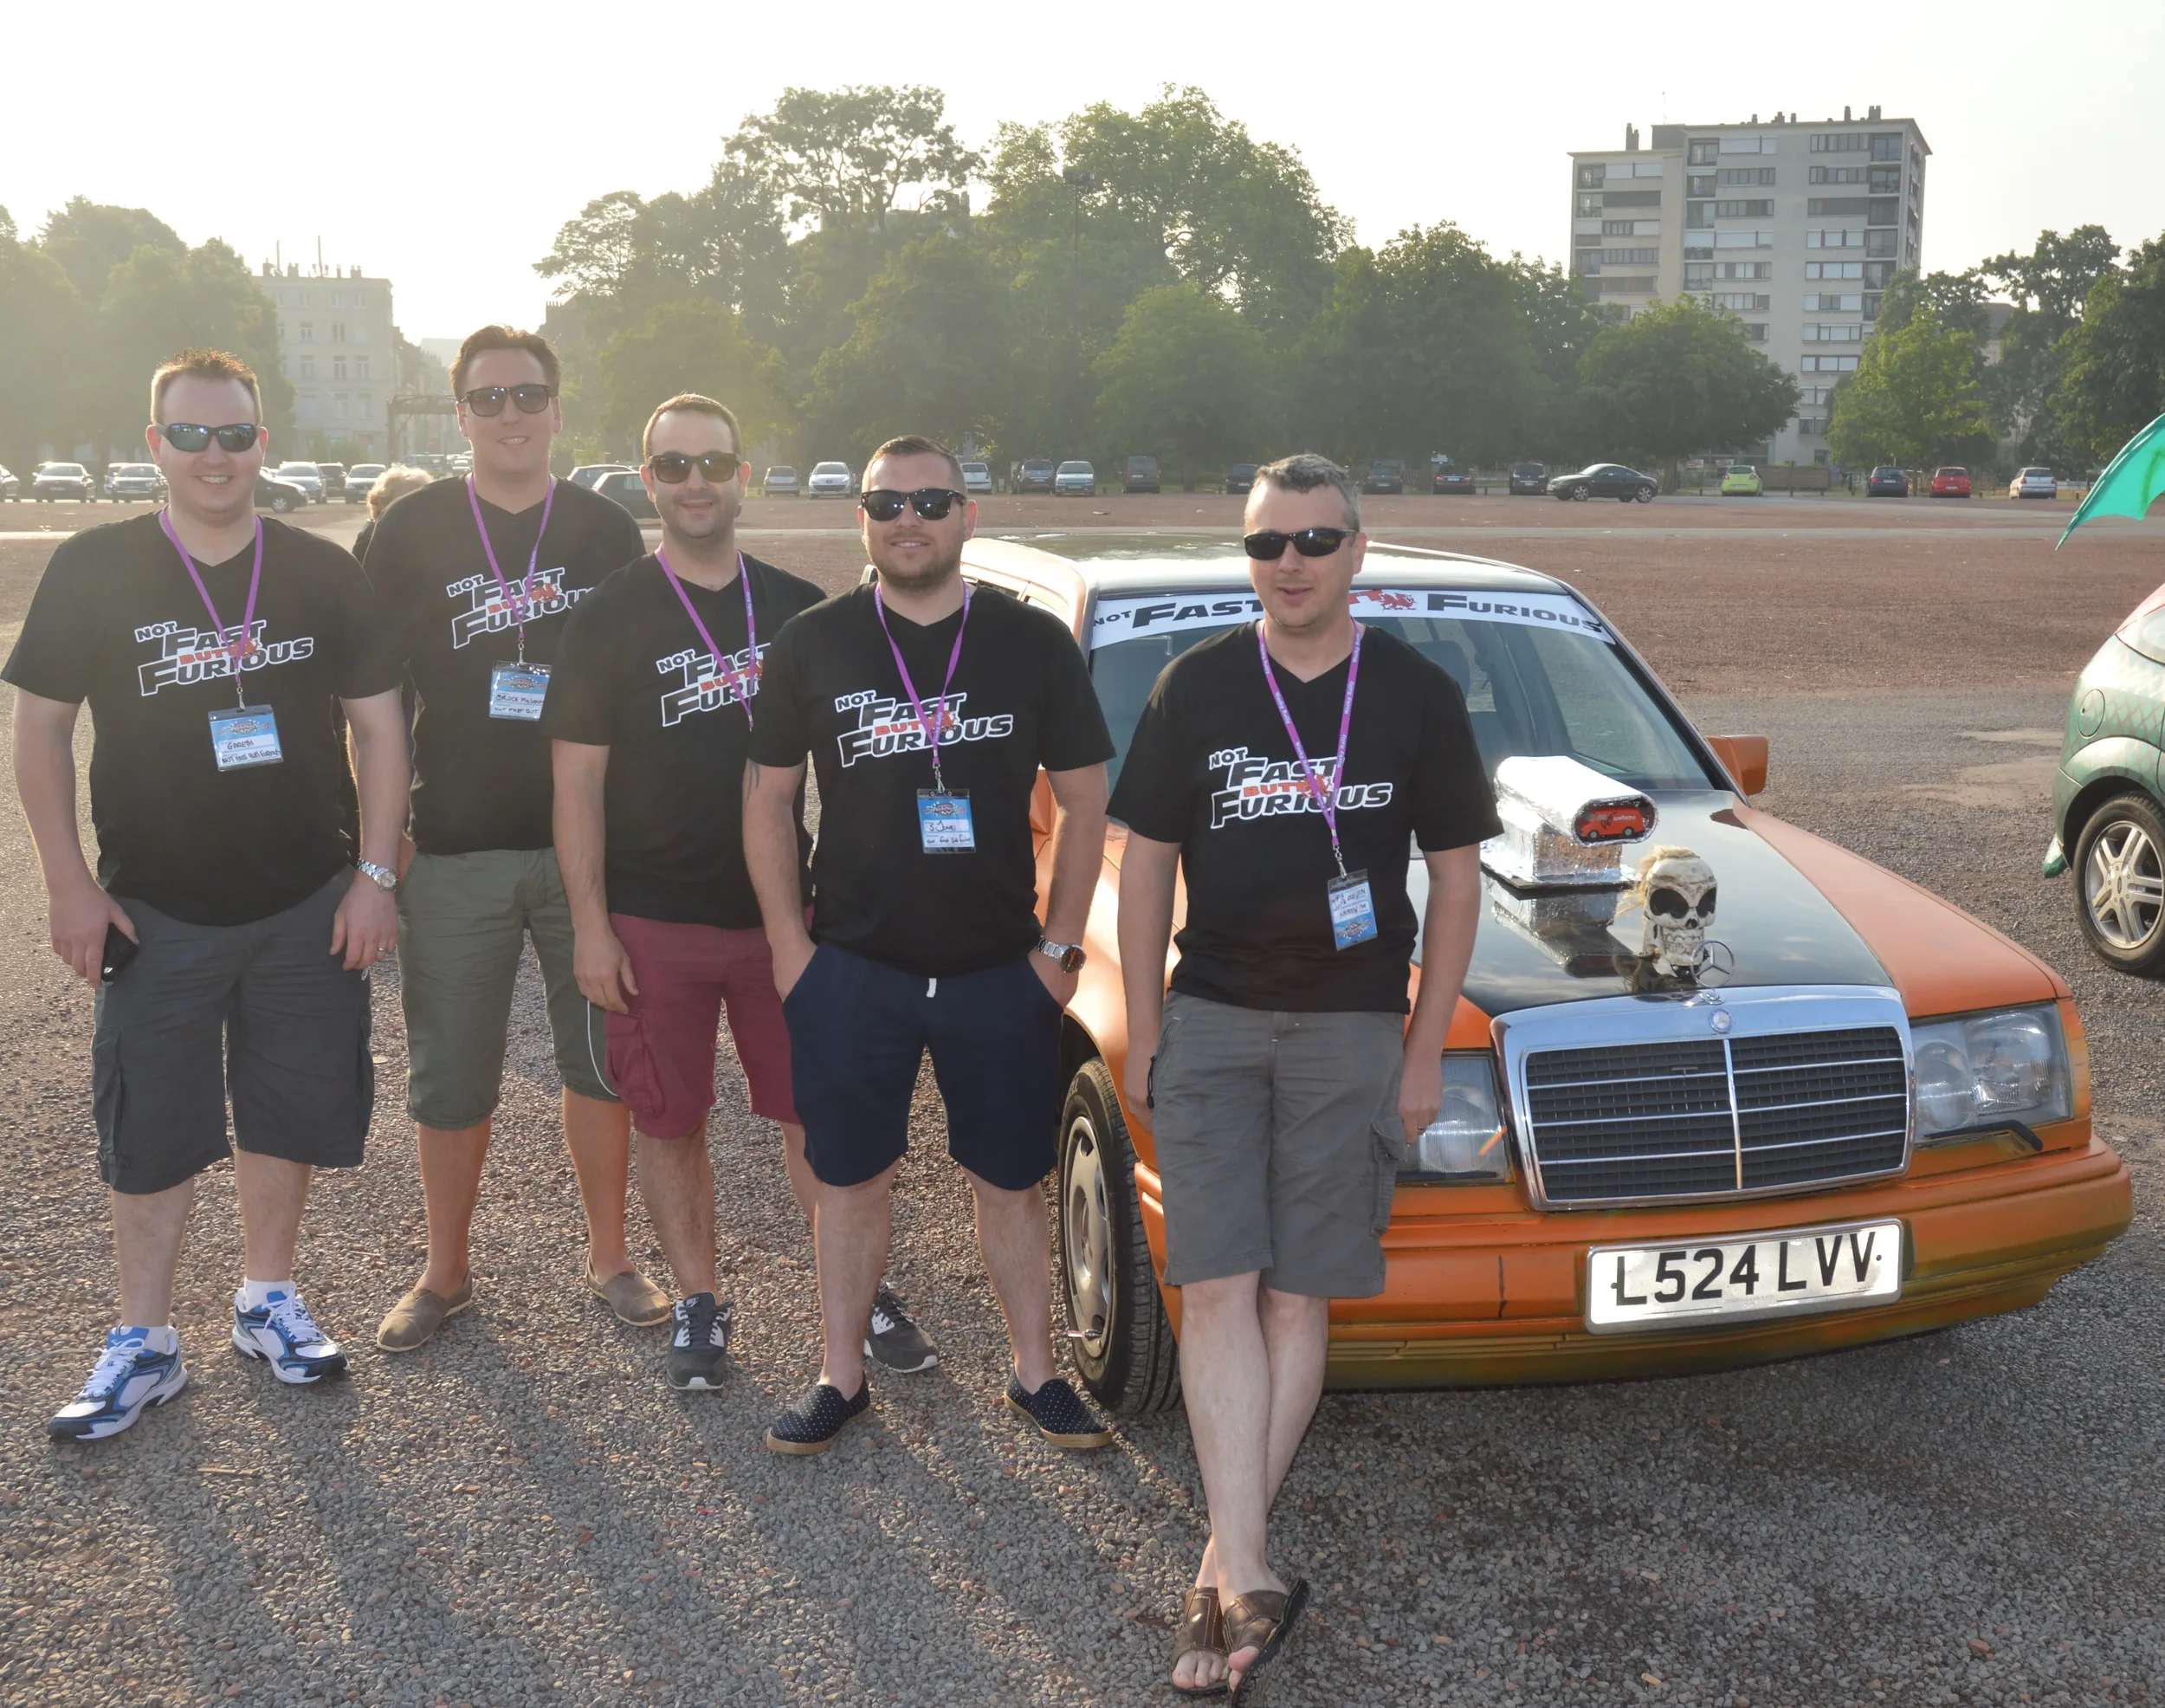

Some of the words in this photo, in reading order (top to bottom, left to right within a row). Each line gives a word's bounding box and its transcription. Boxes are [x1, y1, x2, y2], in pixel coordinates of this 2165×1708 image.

[446, 574, 484, 598] NOT
[472, 567, 565, 610] FAST
[1094, 611, 1132, 626] NOT
[1132, 600, 1264, 628] FAST
[1427, 593, 1602, 633] FURIOUS
[134, 620, 178, 643] NOT
[162, 619, 267, 659] FAST
[656, 649, 695, 674] NOT
[835, 689, 876, 712] NOT
[858, 692, 966, 730] FAST
[227, 740, 254, 750] GARETH
[1209, 747, 1248, 770] NOT
[1226, 757, 1345, 791] FAST
[1211, 782, 1393, 829] FURIOUS
[1616, 1245, 1760, 1306] L524
[1777, 1232, 1876, 1292] LVV
